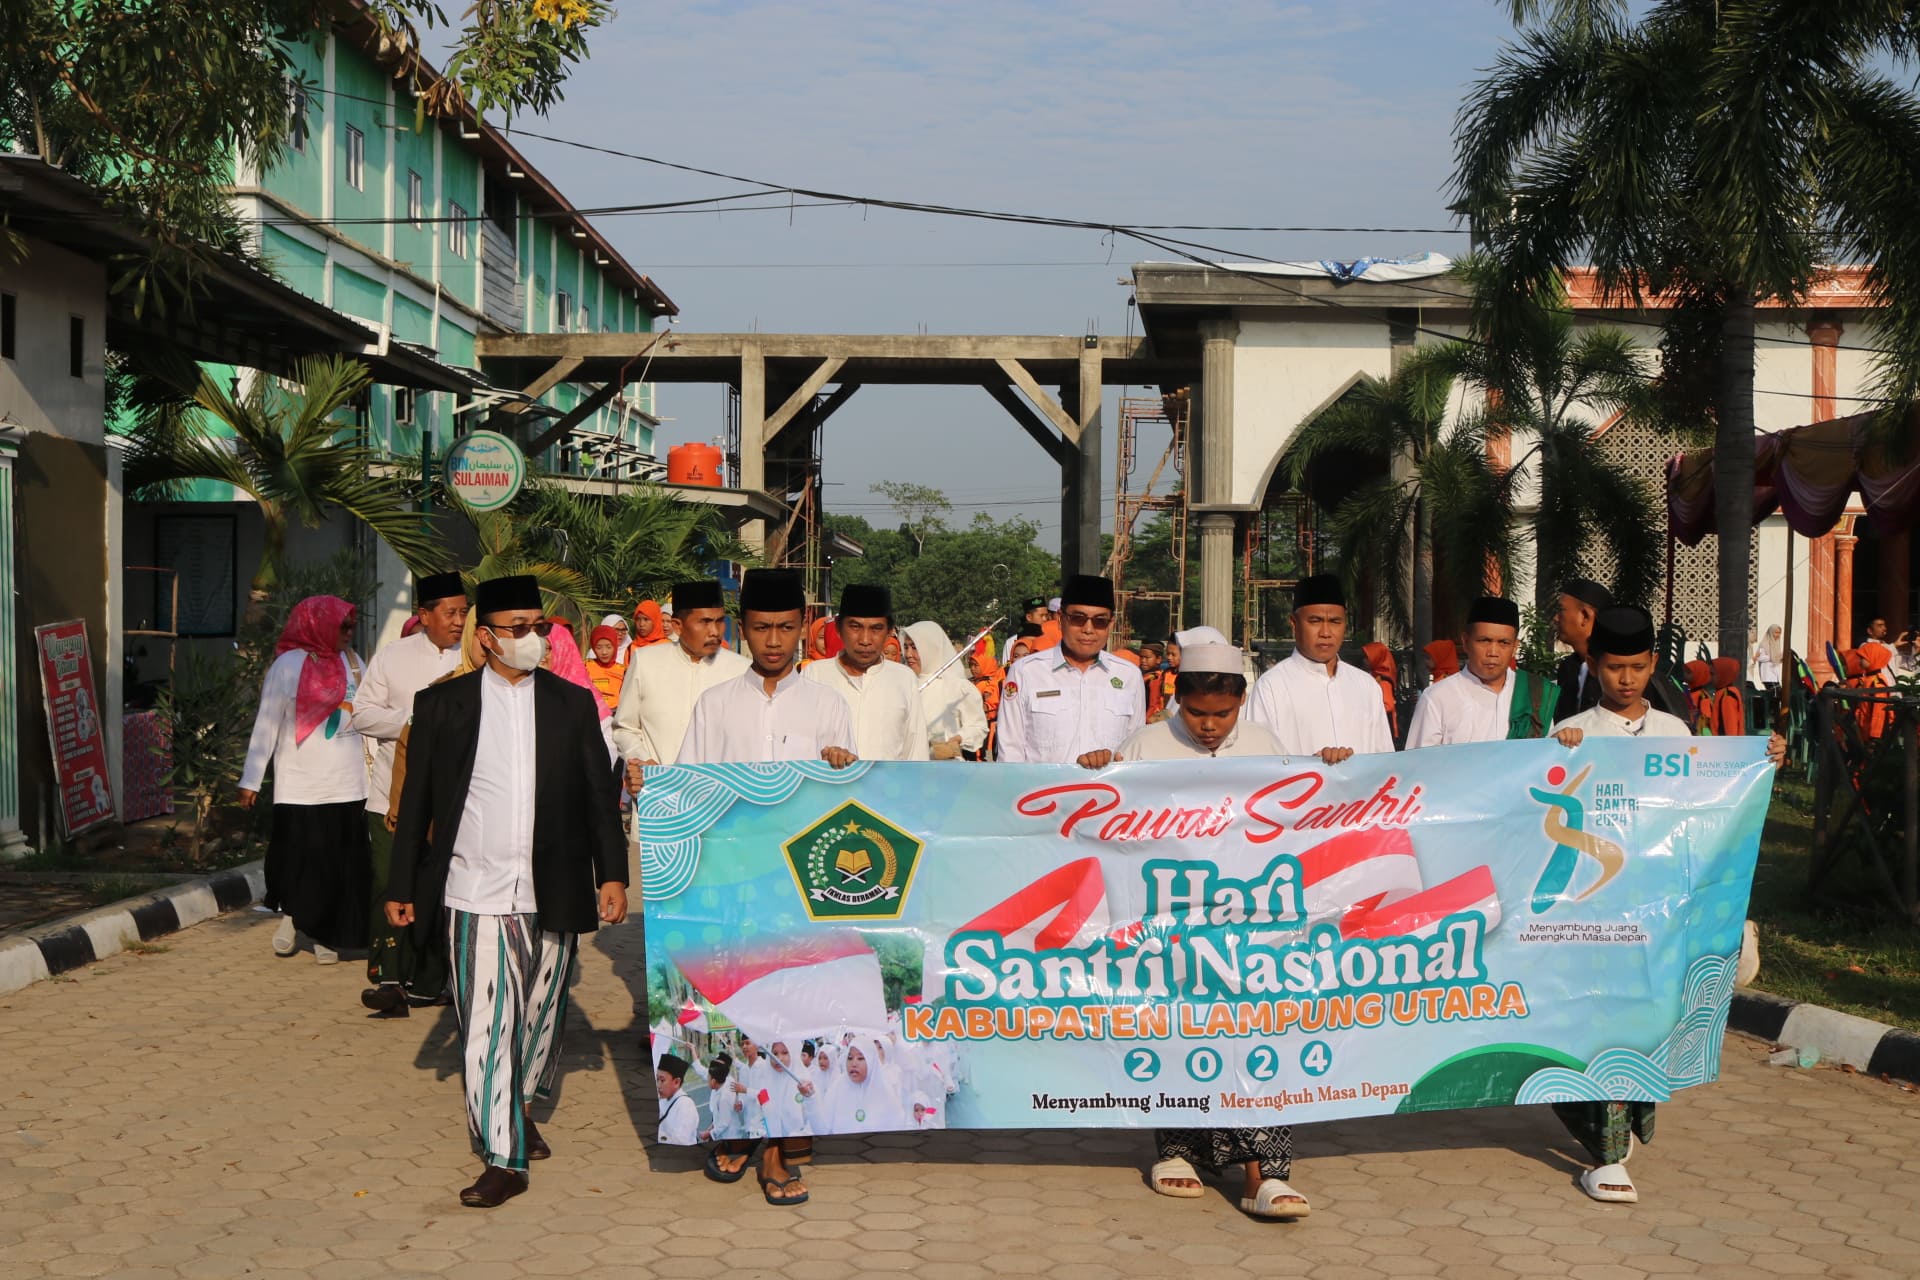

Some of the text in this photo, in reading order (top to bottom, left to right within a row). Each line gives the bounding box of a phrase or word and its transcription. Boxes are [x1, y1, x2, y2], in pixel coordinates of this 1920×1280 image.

[451, 456, 468, 471] BIN
[454, 472, 509, 487] SULAIMAN
[1644, 753, 1690, 777] BSI
[1696, 760, 1721, 769] BANK
[1596, 783, 1623, 797] HARI
[1017, 772, 1421, 844] Pawai Santri
[826, 886, 883, 903] IKHLAS BERAMAL
[1152, 862, 1299, 926] Hari
[1529, 922, 1638, 934] Menyambung Juang
[1519, 932, 1648, 944] Merengkuh Masa Depan
[953, 918, 1480, 1001] Santri Nasional
[905, 985, 1527, 1039] KABUPATEN LAMPUNG UTARA
[1032, 1082, 1410, 1113] Menyambung Juang Merengkuh Masa Depan
